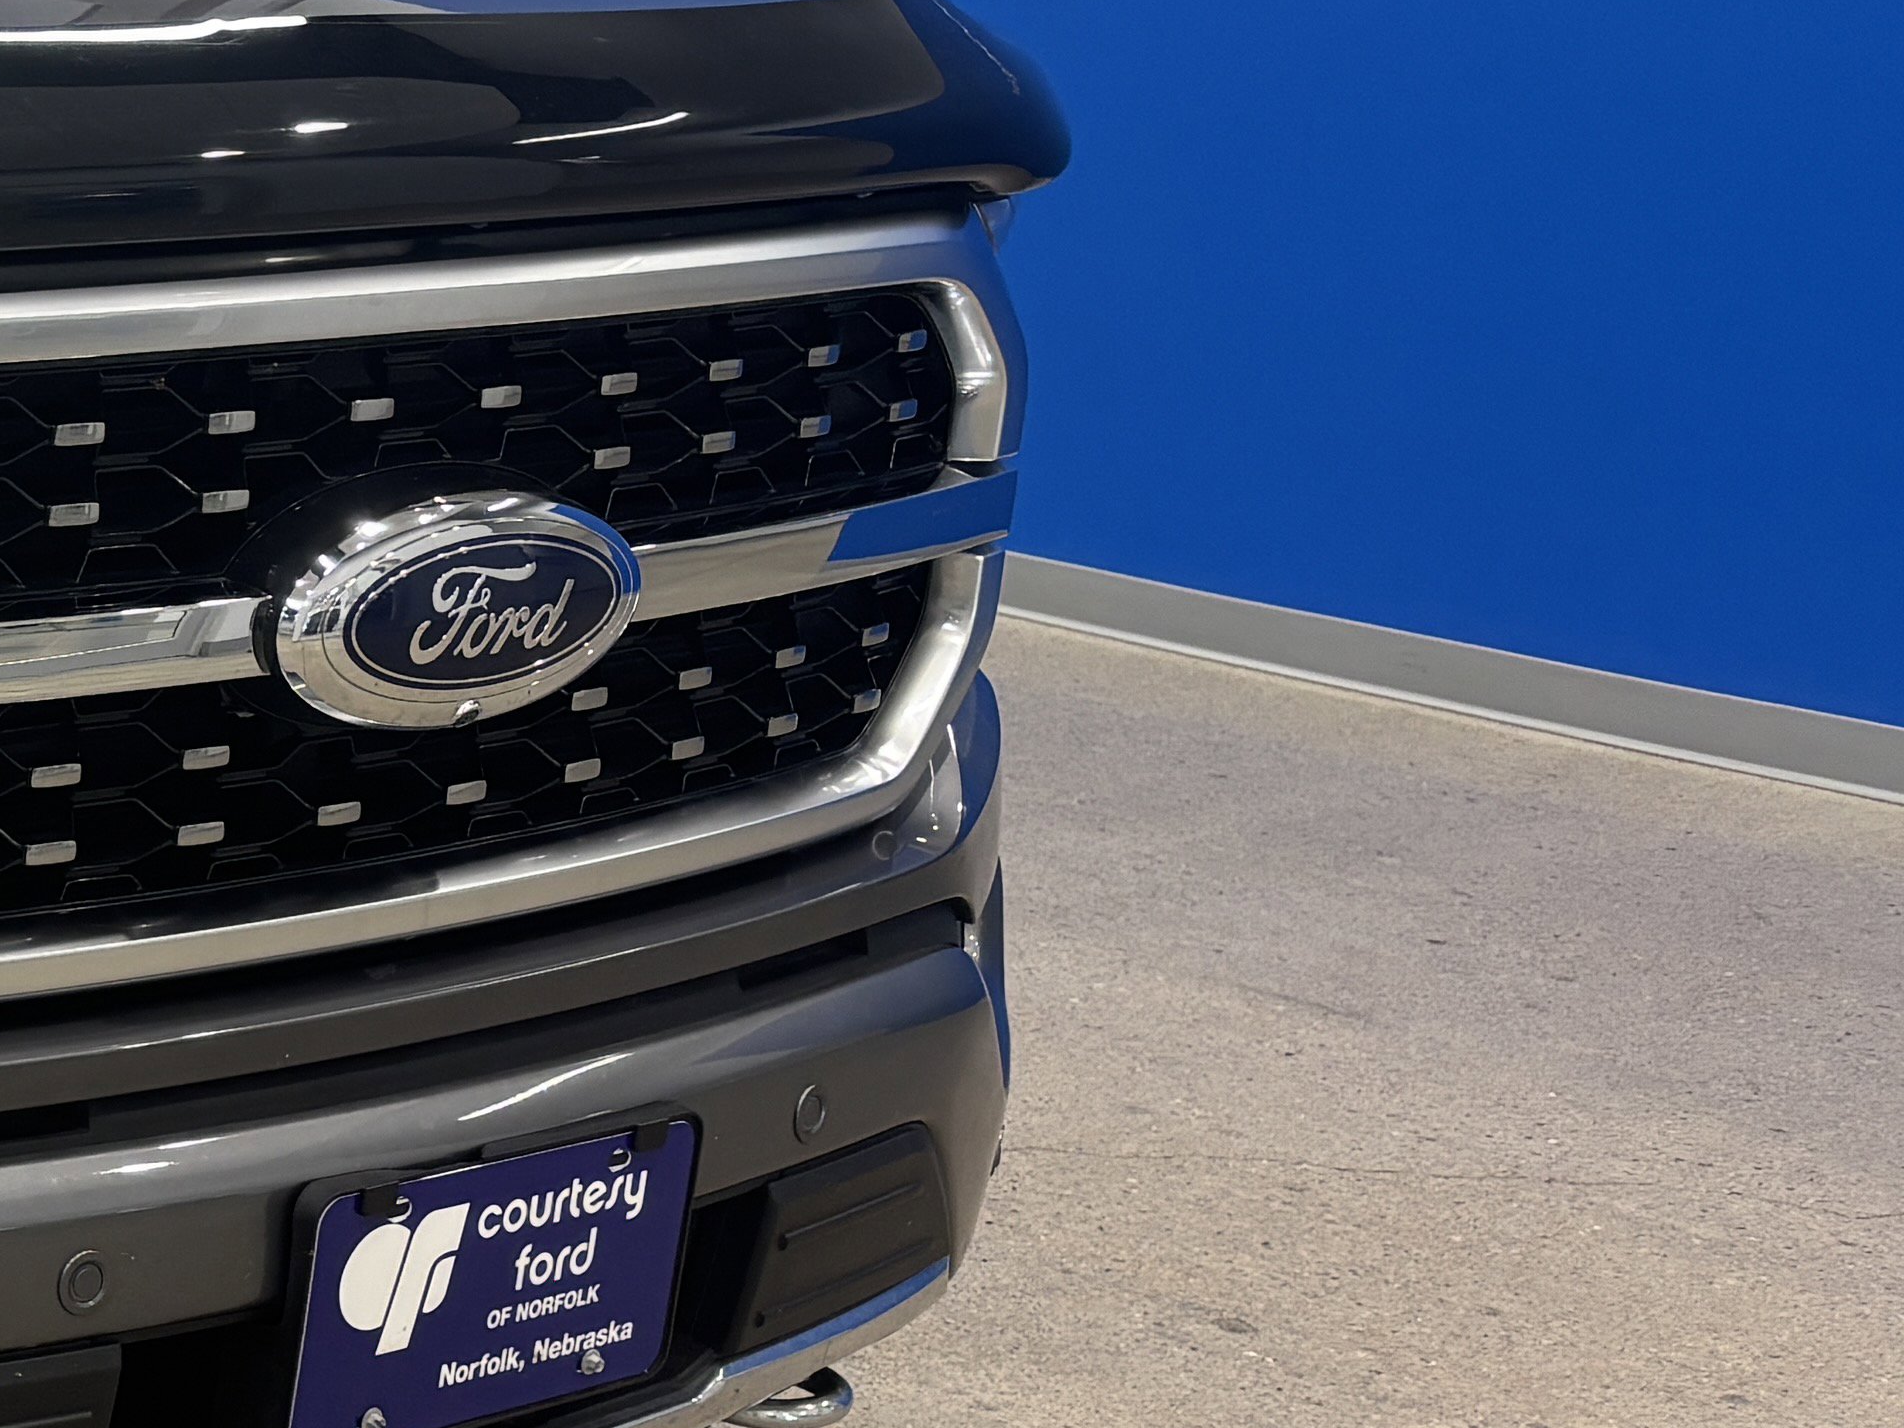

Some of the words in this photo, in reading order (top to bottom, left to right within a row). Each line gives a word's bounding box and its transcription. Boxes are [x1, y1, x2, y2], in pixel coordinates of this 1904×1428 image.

[408, 560, 576, 666] Ford
[477, 1169, 649, 1239] courtesy
[514, 1225, 598, 1291] ford
[486, 1305, 513, 1330] OF
[514, 1283, 601, 1323] NORFOLK
[437, 1346, 526, 1389] Norfolk,
[531, 1319, 635, 1365] Nebraska
